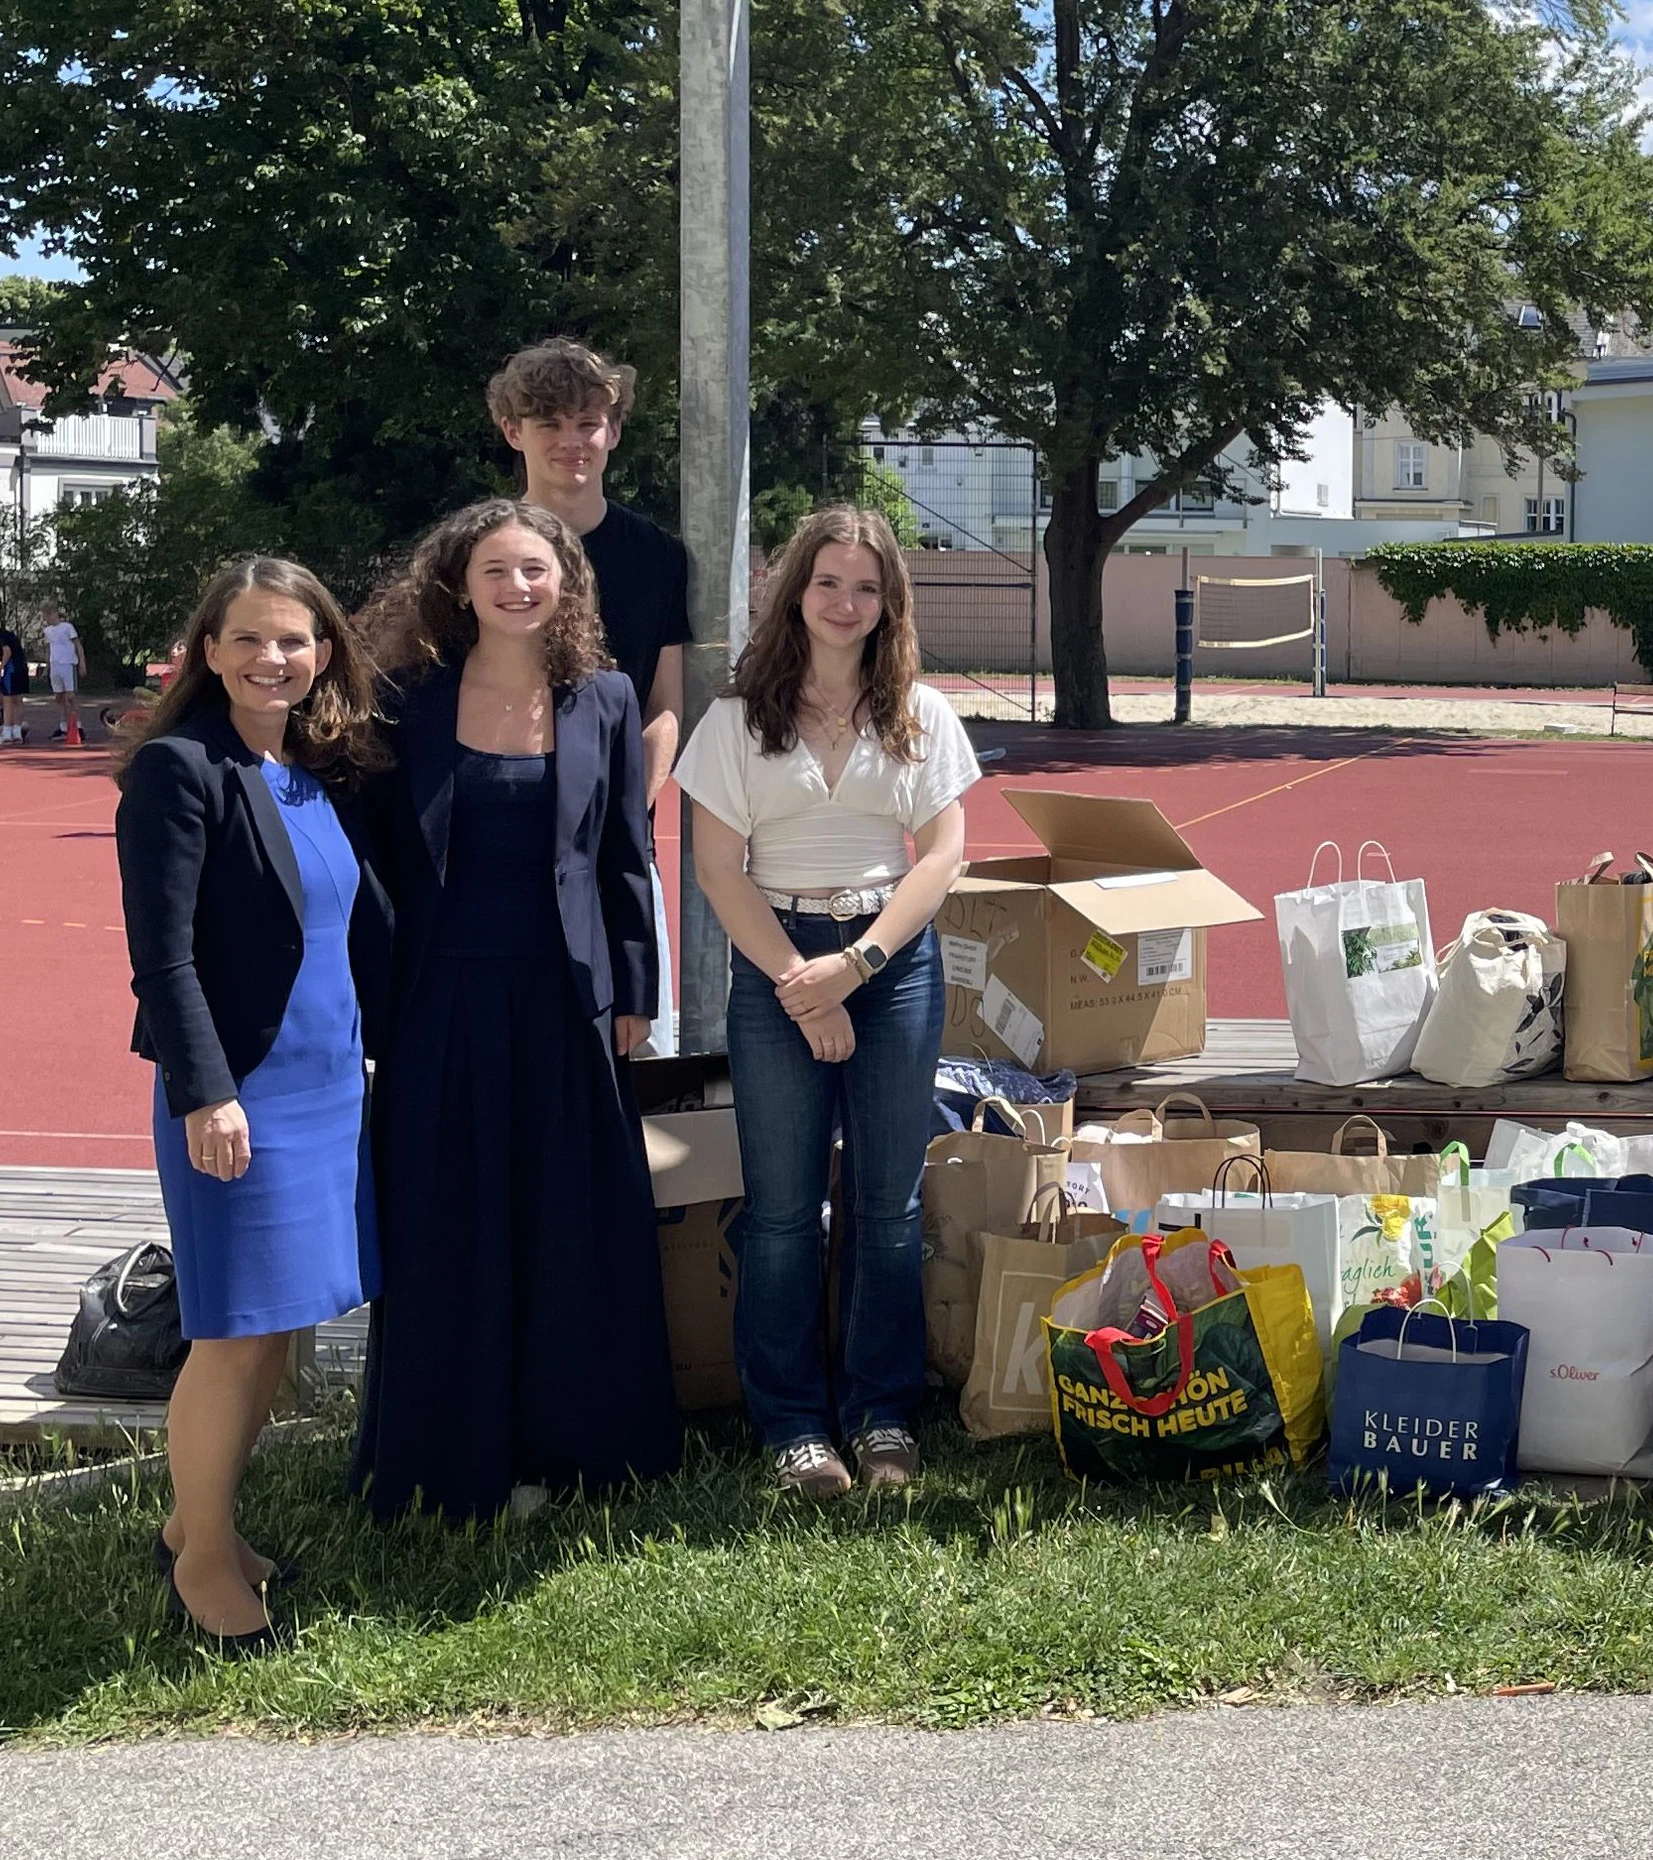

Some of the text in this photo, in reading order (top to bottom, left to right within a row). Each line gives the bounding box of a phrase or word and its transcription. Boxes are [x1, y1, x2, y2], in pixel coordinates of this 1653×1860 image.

[1549, 1364, 1601, 1381] s.Oliver
[1058, 1374, 1128, 1411] GANZ
[1062, 1388, 1248, 1438] FRISCH HEUTE
[1365, 1410, 1478, 1439] KLEIDER
[1364, 1430, 1477, 1460] BAUER
